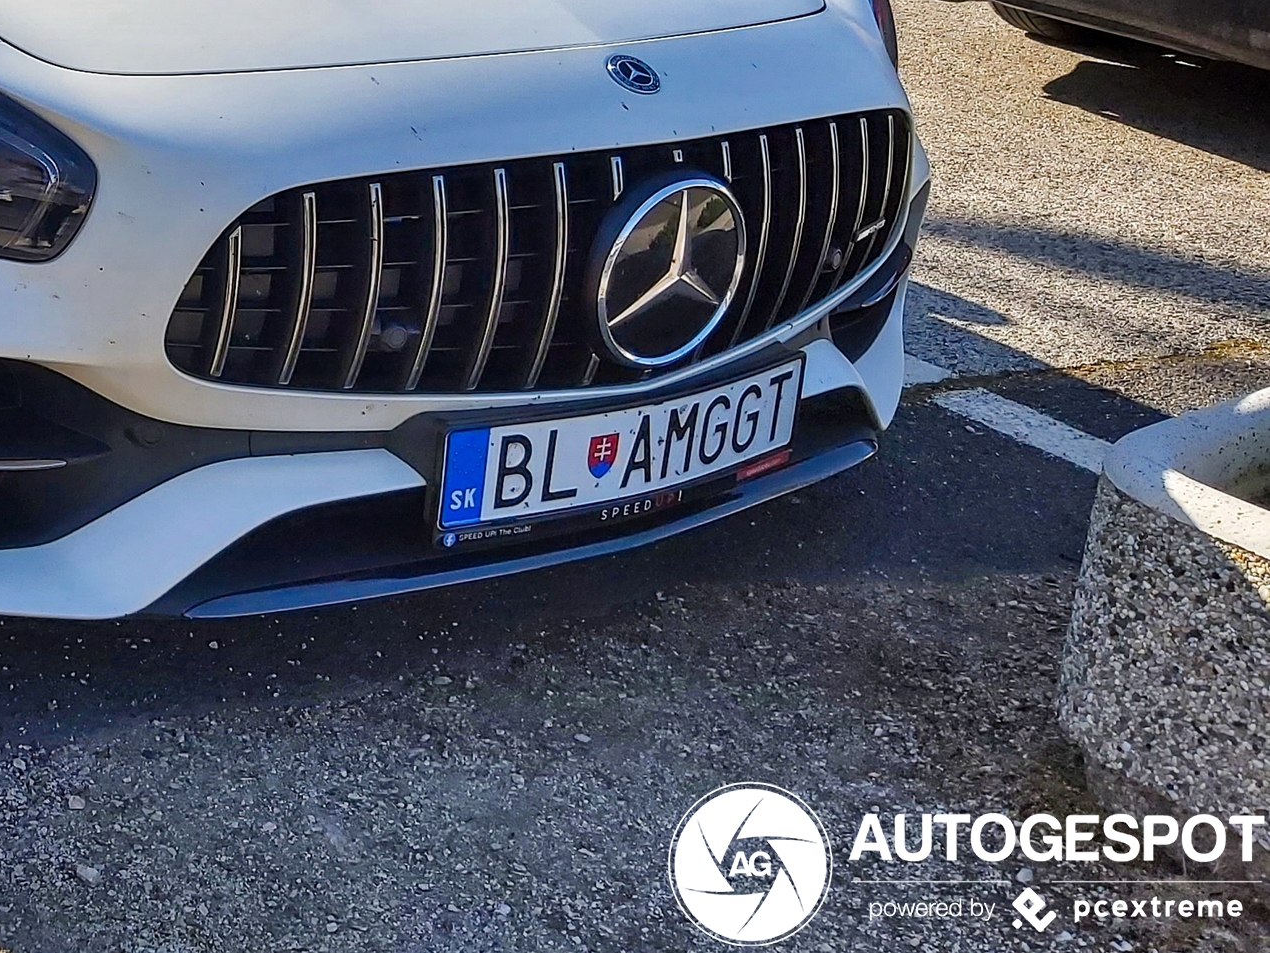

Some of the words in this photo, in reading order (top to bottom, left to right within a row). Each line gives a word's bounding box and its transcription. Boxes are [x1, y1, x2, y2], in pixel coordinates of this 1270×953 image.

[493, 429, 578, 509] BL
[619, 370, 794, 489] AMGGT
[450, 488, 477, 510] SK
[458, 531, 483, 542] SPEED
[499, 528, 512, 536] The
